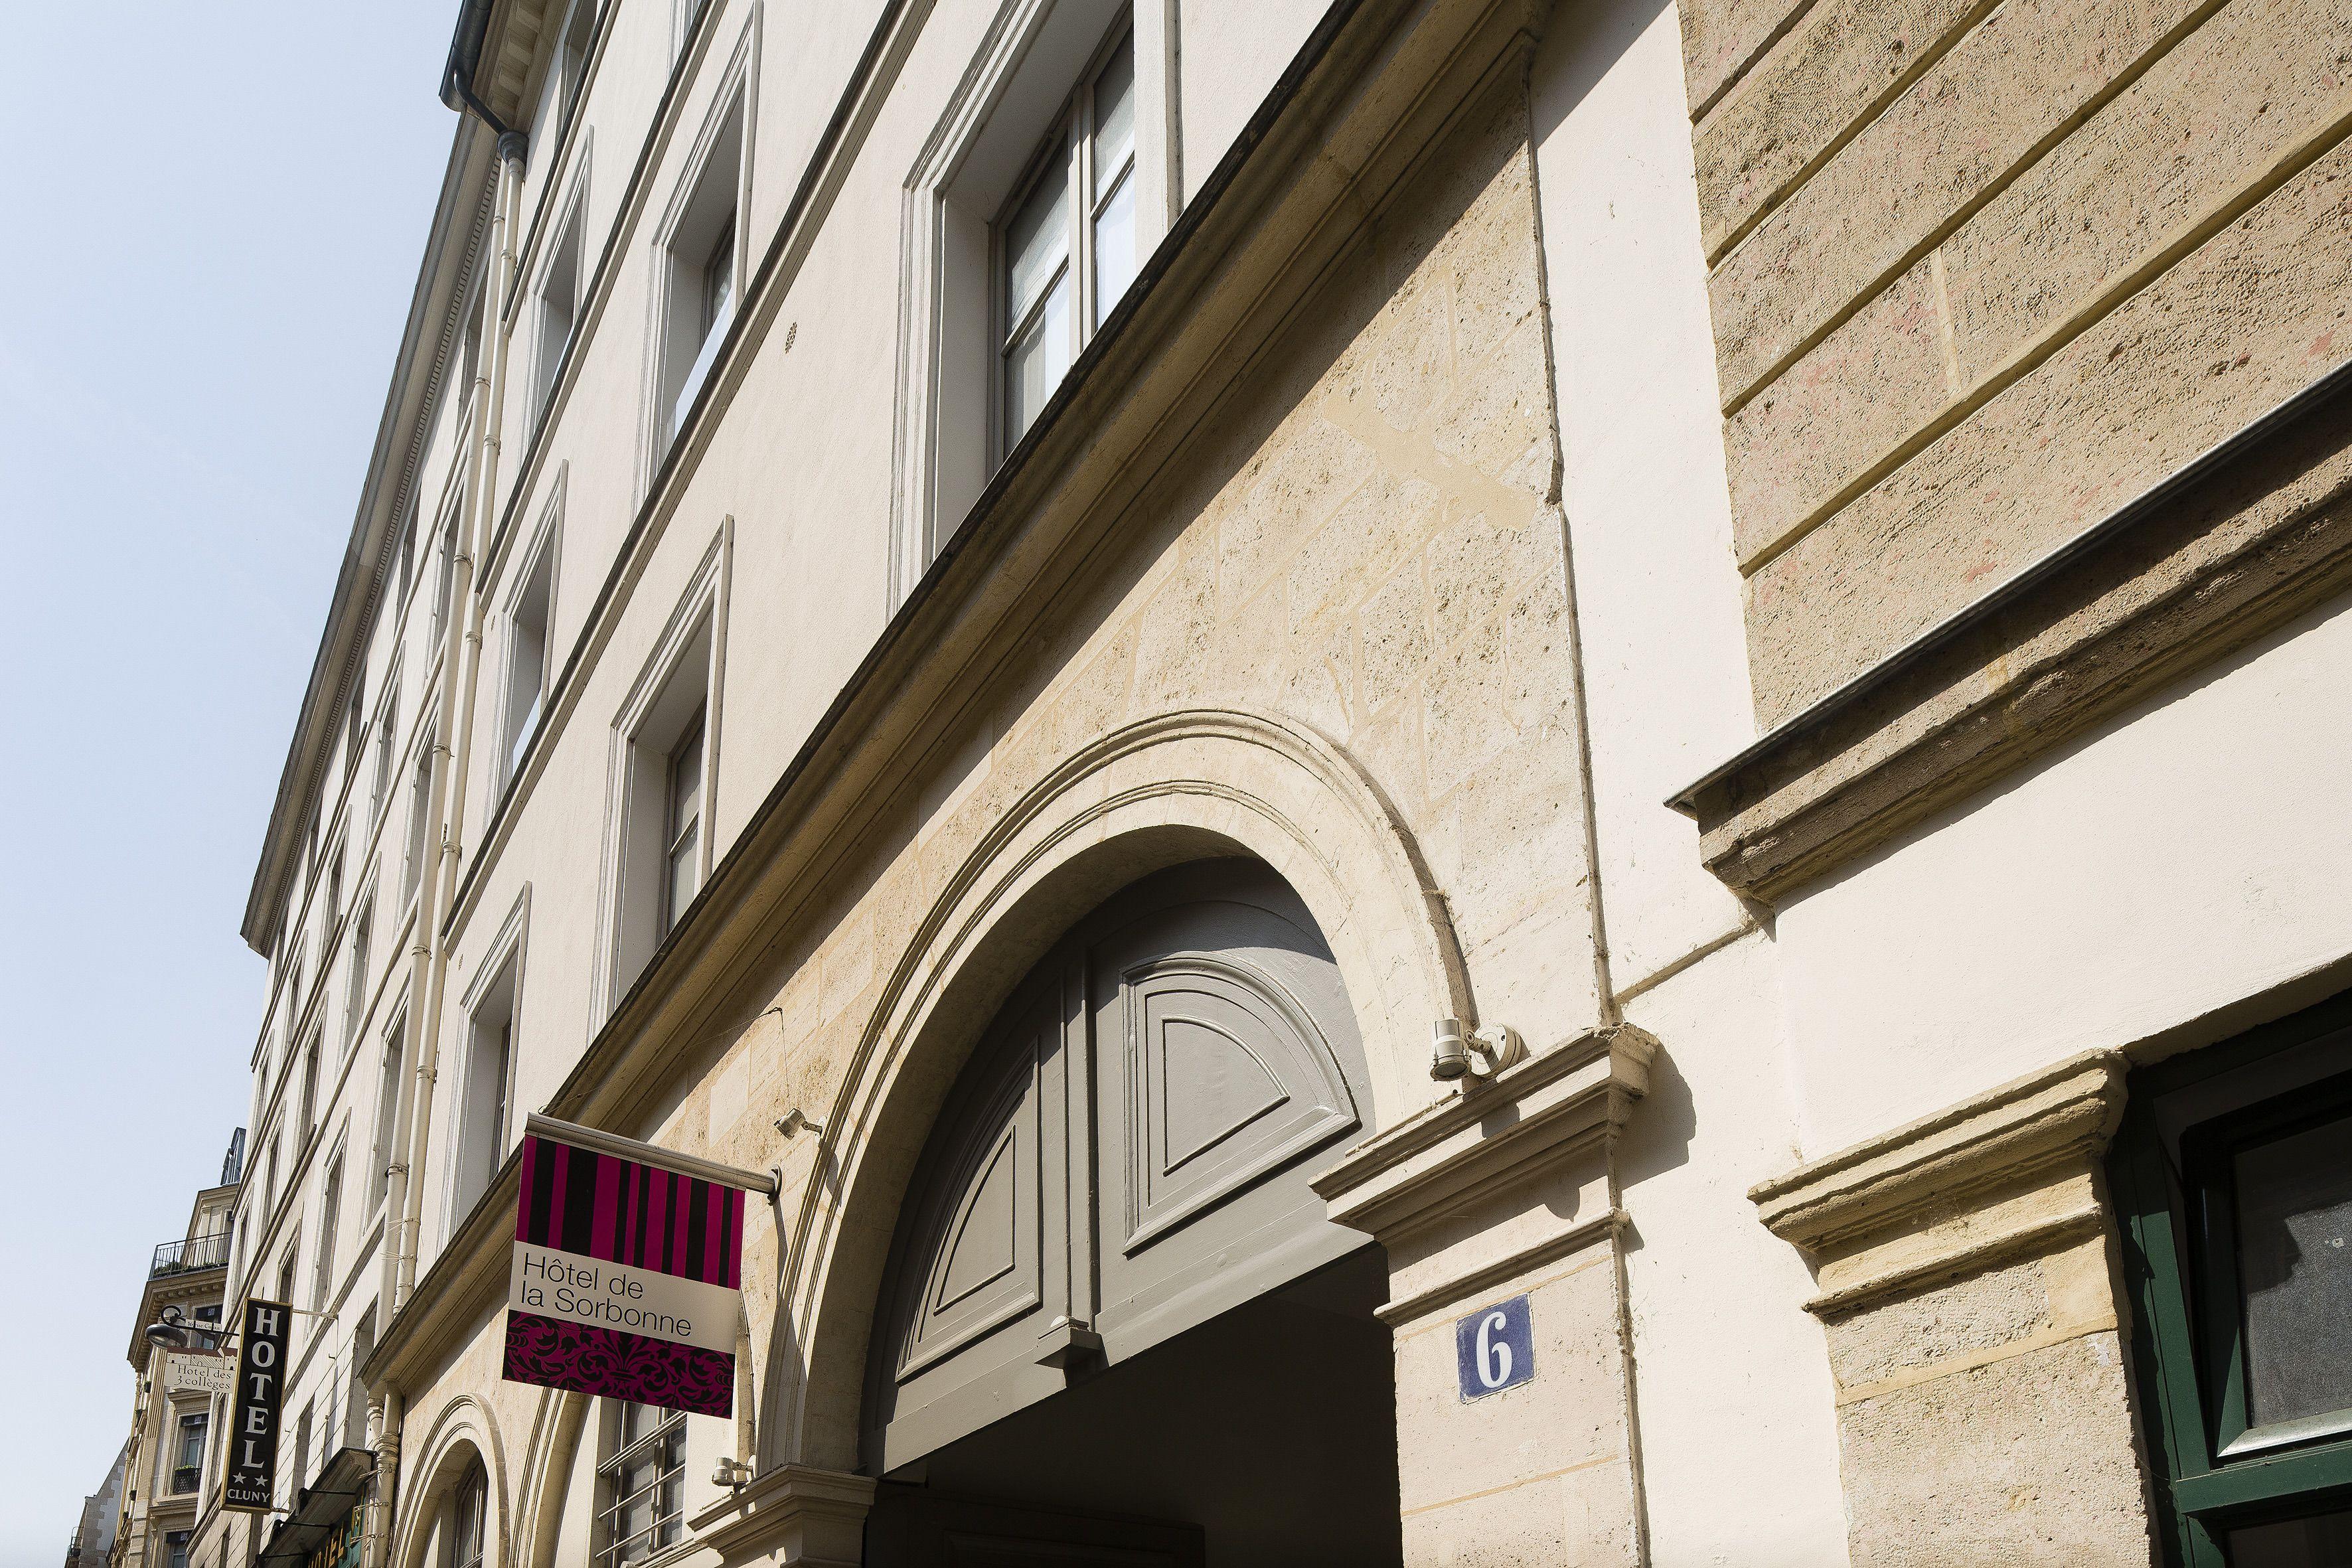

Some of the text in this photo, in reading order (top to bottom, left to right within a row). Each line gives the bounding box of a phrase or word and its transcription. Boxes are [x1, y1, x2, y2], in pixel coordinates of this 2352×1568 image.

[523, 1252, 643, 1300] Hôtel de
[520, 1280, 692, 1337] la Sorbonne
[178, 1364, 232, 1379] Hotel des
[1476, 1311, 1512, 1389] 6
[174, 1375, 231, 1391] 3 collèges
[241, 1306, 281, 1469] HOTEL
[227, 1488, 270, 1503] CLUNY
